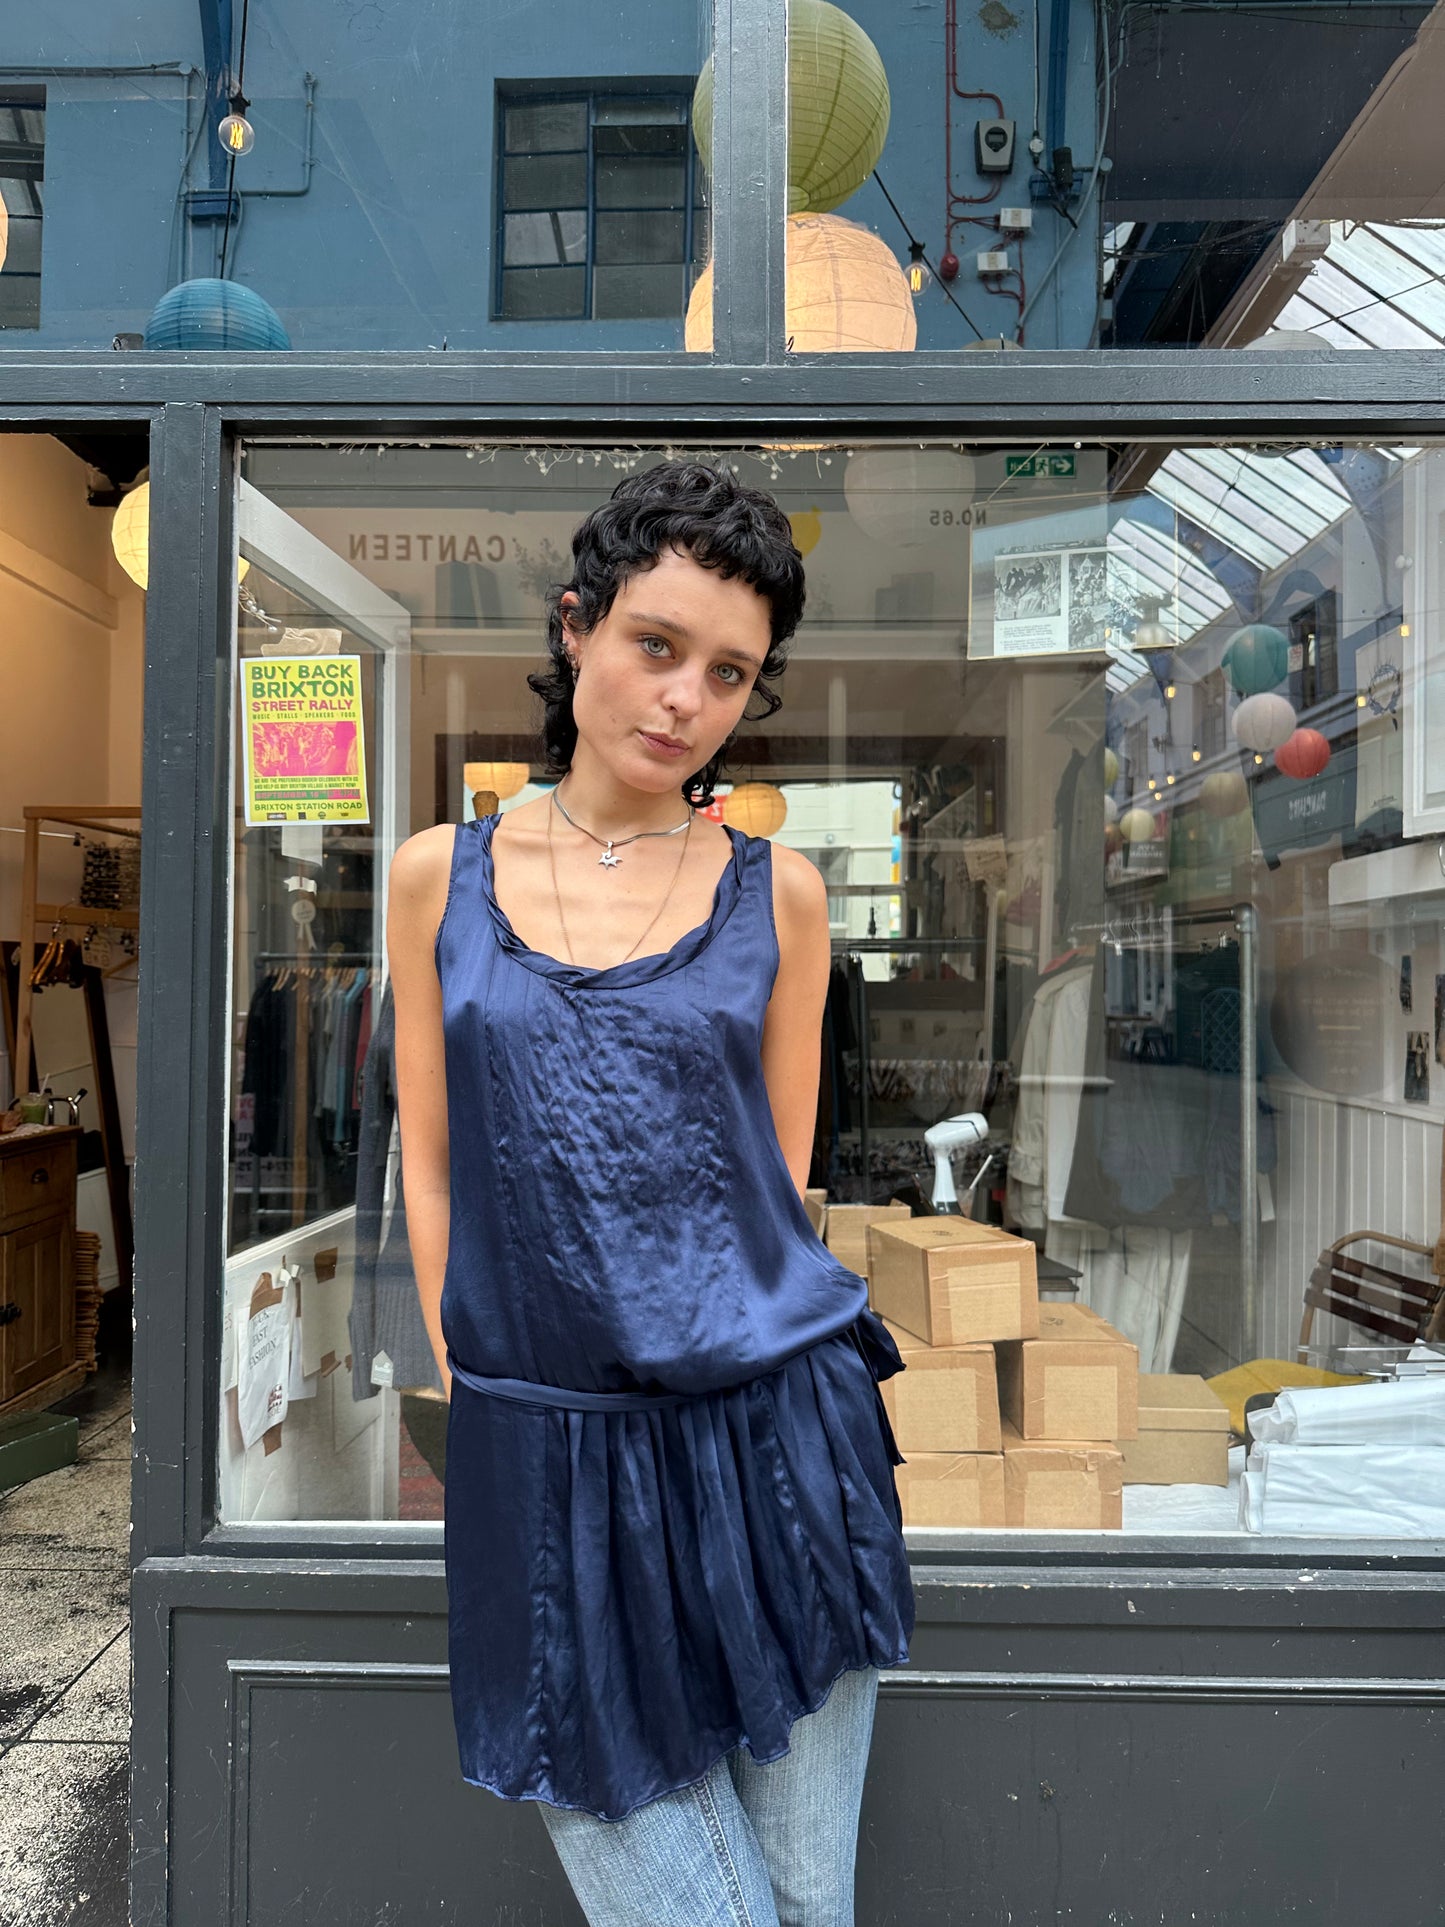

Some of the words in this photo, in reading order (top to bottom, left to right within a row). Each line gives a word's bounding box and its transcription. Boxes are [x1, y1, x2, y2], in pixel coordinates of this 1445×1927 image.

[251, 666, 291, 680] BUY
[298, 664, 353, 679] BACK
[252, 680, 355, 699] BRIXTON
[252, 700, 305, 712] STREET
[309, 699, 354, 711] RALLY
[255, 791, 307, 799] SEPTEMBER
[254, 803, 293, 811] BRIXTON
[295, 802, 334, 811] STATION
[336, 801, 363, 810] ROAD
